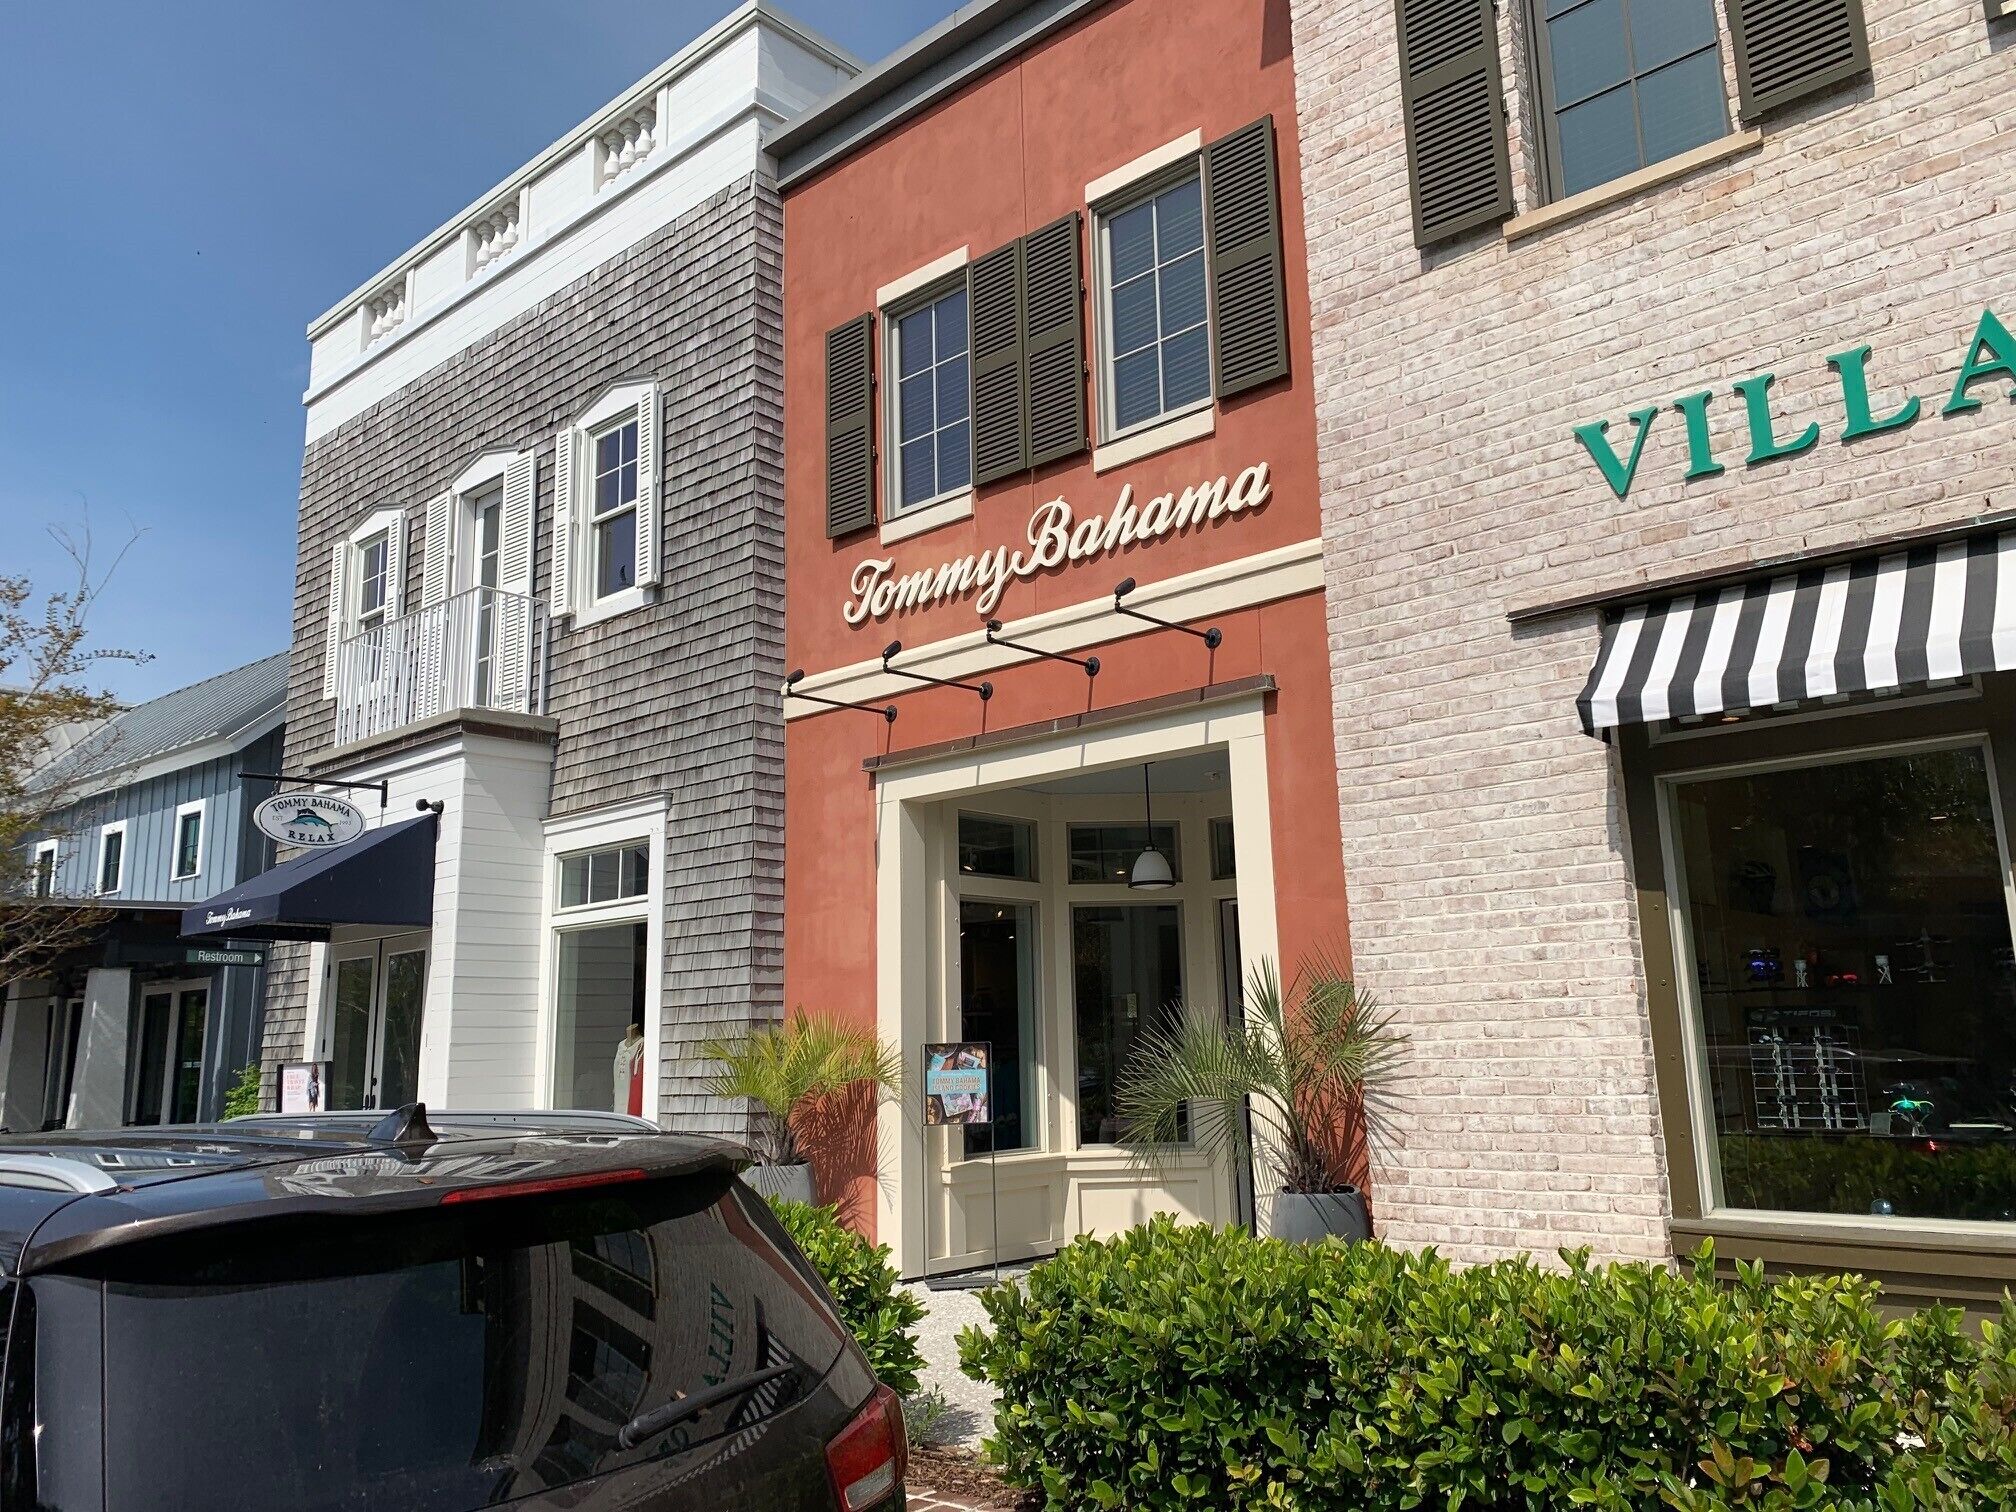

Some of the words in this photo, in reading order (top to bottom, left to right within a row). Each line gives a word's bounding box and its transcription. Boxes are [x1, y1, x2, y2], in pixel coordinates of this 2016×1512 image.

[1571, 308, 2016, 498] VILLA
[843, 545, 1009, 624] Tommy
[1010, 461, 1272, 576] Bahama
[270, 798, 308, 812] TOMMY
[311, 798, 351, 817] BAHAMA
[288, 829, 335, 842] RELAX
[205, 911, 227, 928] Tommy
[226, 907, 252, 921] Bahama
[197, 950, 243, 963] Restroom
